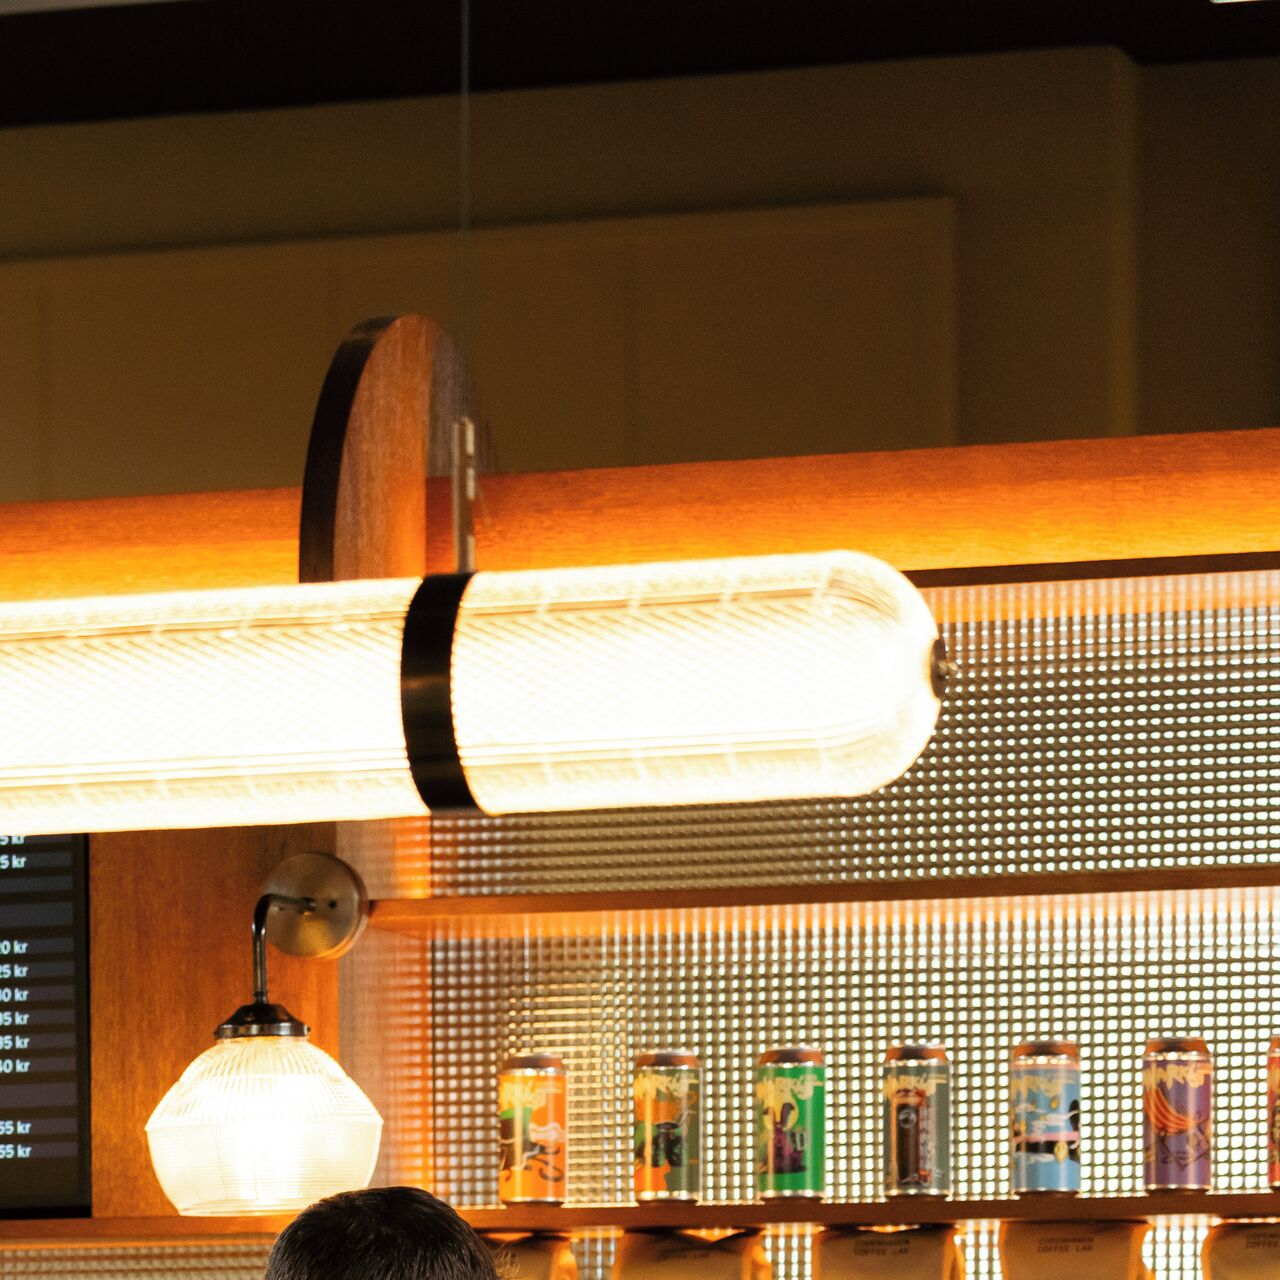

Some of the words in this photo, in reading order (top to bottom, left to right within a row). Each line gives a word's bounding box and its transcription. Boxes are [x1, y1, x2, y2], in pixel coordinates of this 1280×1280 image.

[12, 854, 27, 868] kr
[13, 940, 28, 954] kr
[14, 964, 28, 977] kr
[14, 988, 29, 1001] kr
[15, 1011, 29, 1025] kr
[15, 1035, 30, 1049] kr
[16, 1059, 30, 1073] kr
[17, 1120, 31, 1134] kr
[17, 1144, 32, 1158] kr
